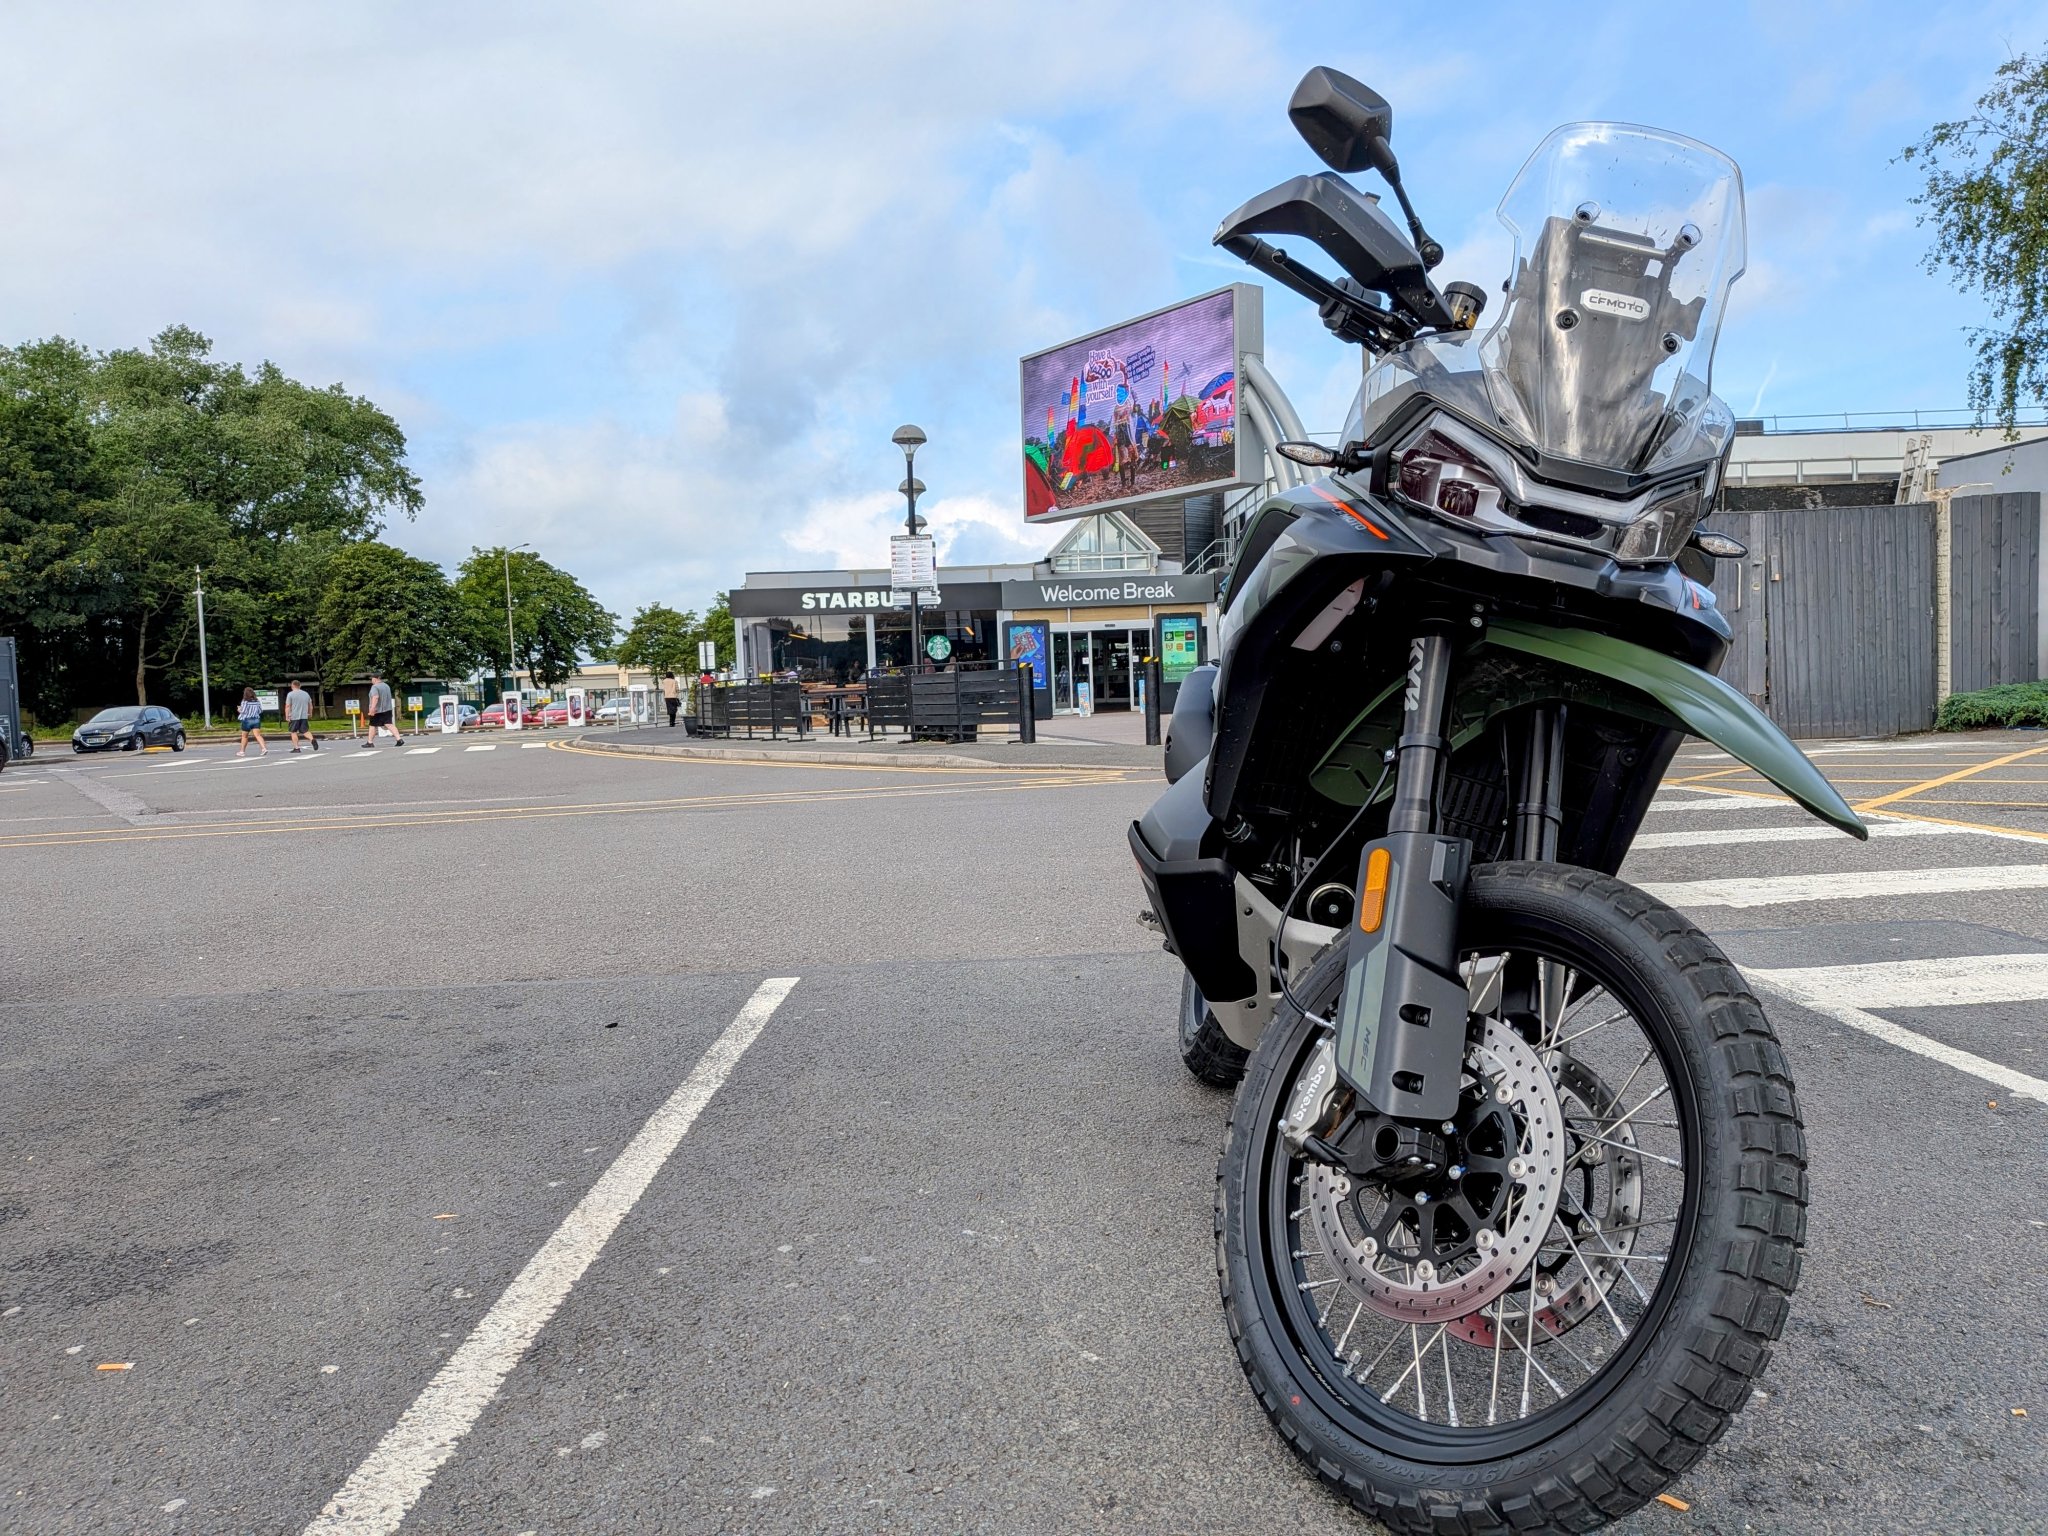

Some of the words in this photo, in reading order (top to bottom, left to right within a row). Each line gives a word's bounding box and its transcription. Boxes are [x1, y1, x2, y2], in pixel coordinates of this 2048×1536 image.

[1589, 295, 1644, 314] CFMOTO
[1089, 351, 1106, 362] Have
[1092, 379, 1108, 391] with
[1087, 386, 1114, 404] yourself
[802, 591, 942, 609] STARBU
[1041, 584, 1120, 603] Welcome
[1123, 581, 1176, 600] Break
[1293, 1064, 1326, 1122] brembo
